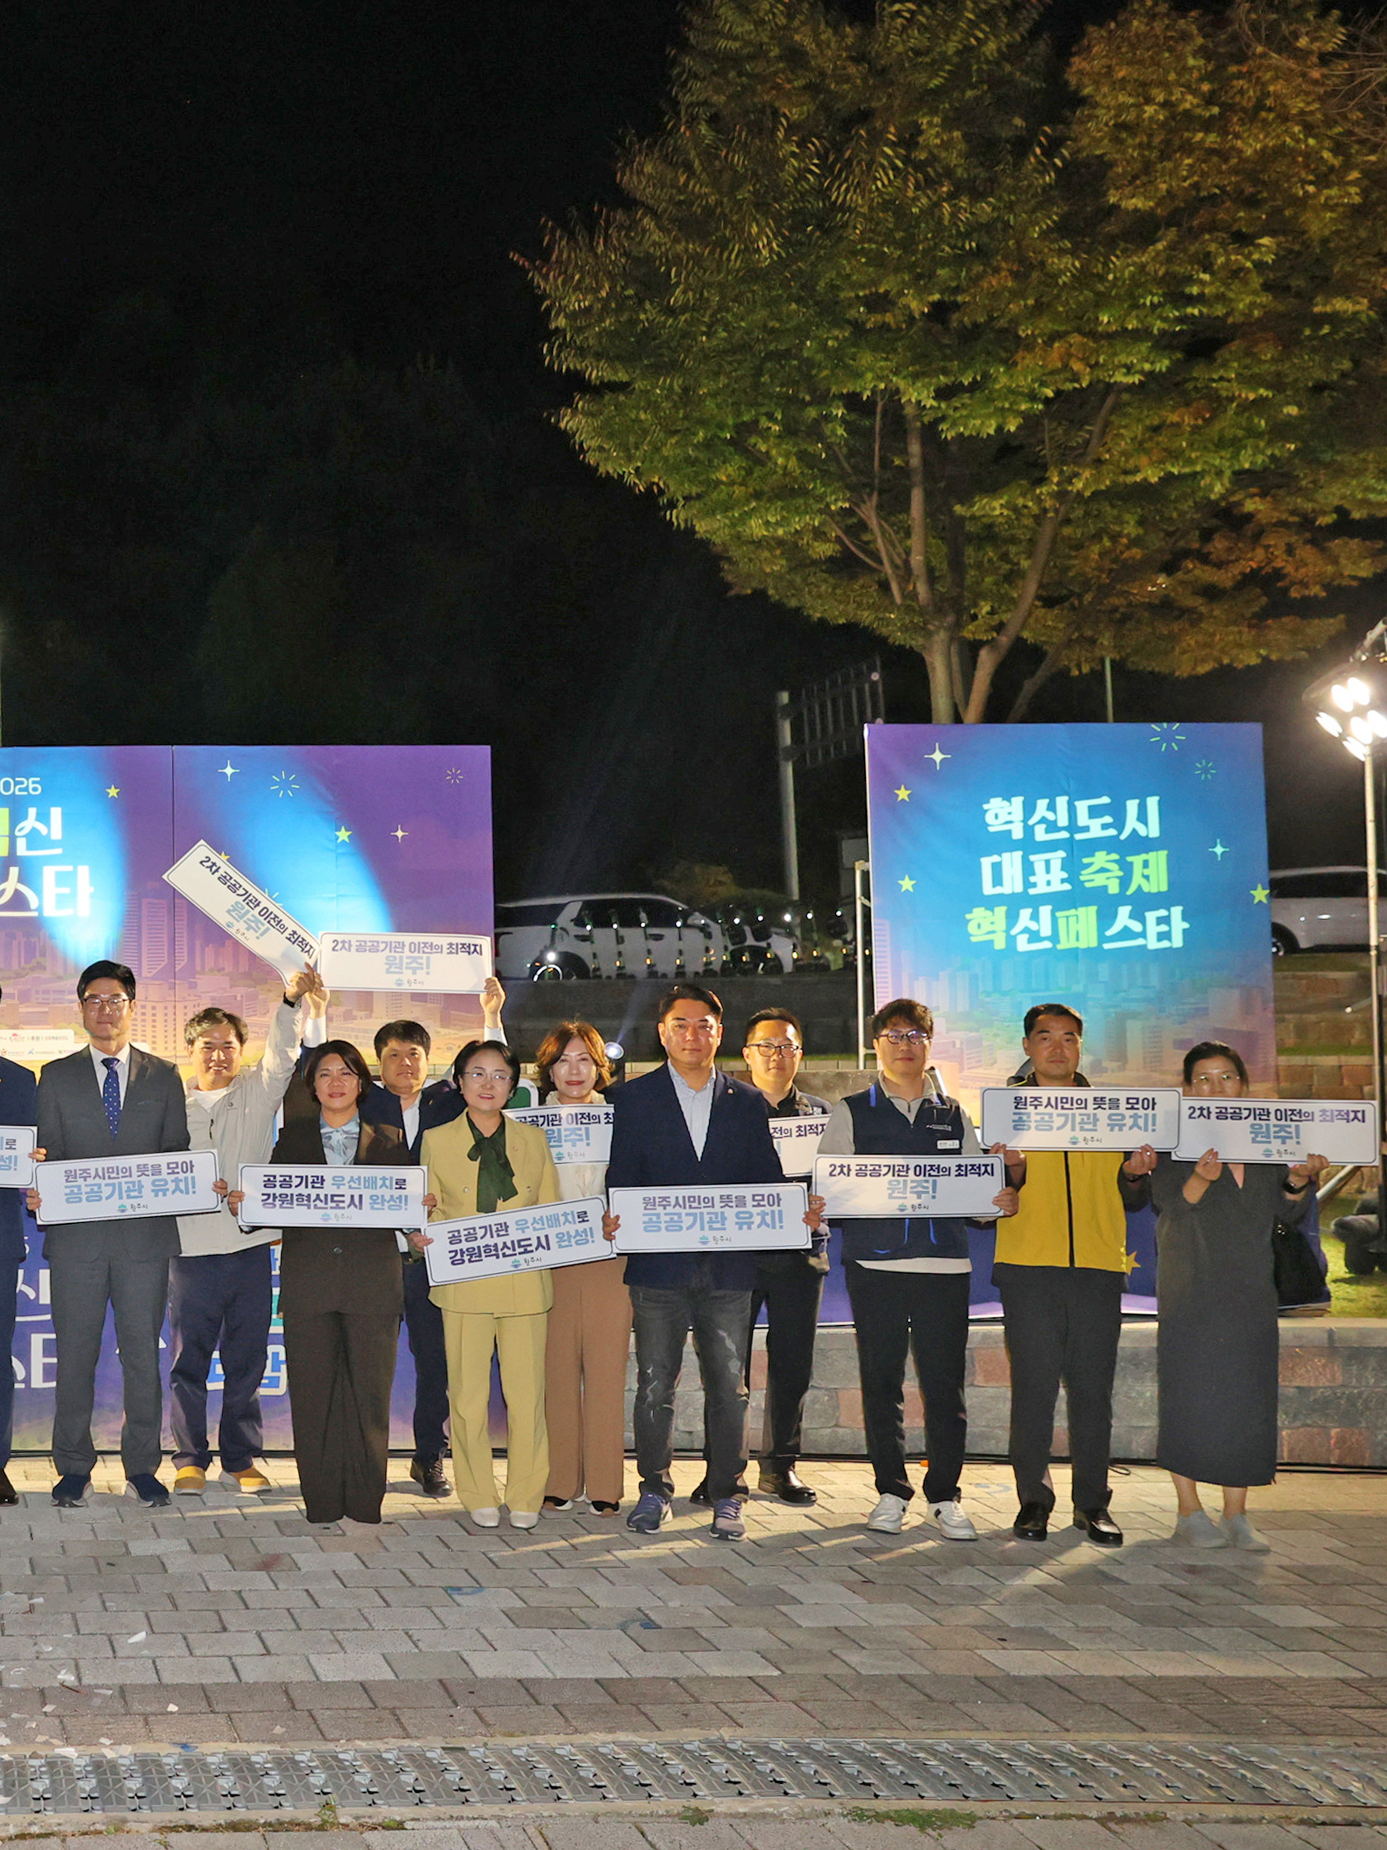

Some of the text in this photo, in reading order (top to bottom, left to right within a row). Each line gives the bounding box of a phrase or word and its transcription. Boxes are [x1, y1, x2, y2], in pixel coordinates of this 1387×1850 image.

[982, 795, 1161, 842] 혁신도시
[980, 850, 1169, 896] 대표 축제
[199, 855, 316, 959] 2차 공공기관 이전의 최적지
[225, 900, 271, 940] 원주!
[965, 904, 1190, 952] 혁신페스타
[331, 939, 483, 956] 2차 공공기관 이전의 최적지
[384, 955, 431, 975] 원주!
[1013, 1095, 1156, 1111] 원주시민의 뜻을 모아
[566, 1112, 601, 1125] 이전의
[1011, 1111, 1157, 1132] 공공기관 유치!
[1187, 1106, 1366, 1123] 2차 공공기관 이전의 최적지
[545, 1127, 591, 1148] 원주!
[771, 1126, 793, 1139] 전의
[1249, 1122, 1300, 1145] 원주!
[63, 1160, 195, 1183] 원주시민의 뜻을 모아
[829, 1163, 994, 1178] 2차 공공기관 이전의 최적지
[64, 1176, 196, 1204] 공공기관 유치!
[262, 1174, 407, 1190] 공공기관 우선배치로
[887, 1179, 937, 1200] 원주!
[261, 1193, 409, 1211] 강원혁신도시 완성!
[642, 1193, 782, 1211] 원주시민의 뜻을 모아
[447, 1210, 590, 1246] 공공기관 우선배치로
[642, 1209, 784, 1234] 공공기관 유치!
[448, 1227, 595, 1266] 강원혁신도시 완성!
